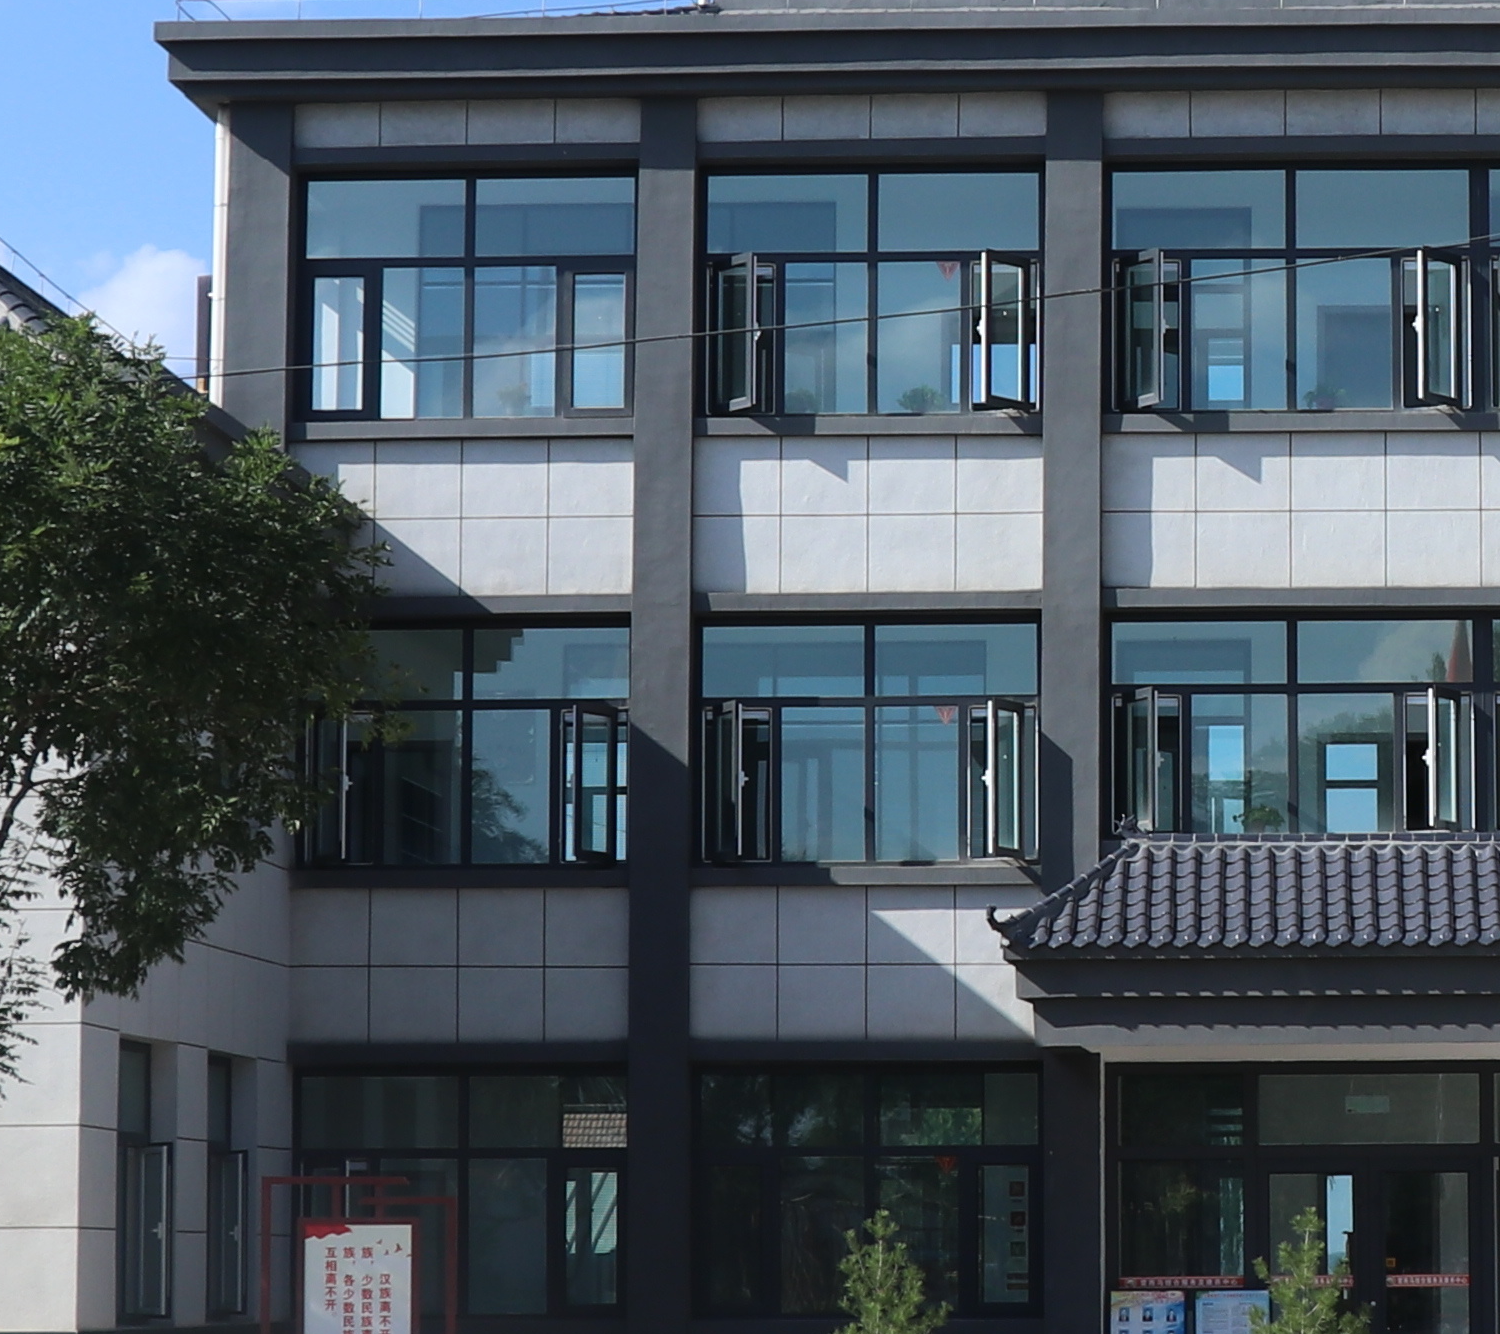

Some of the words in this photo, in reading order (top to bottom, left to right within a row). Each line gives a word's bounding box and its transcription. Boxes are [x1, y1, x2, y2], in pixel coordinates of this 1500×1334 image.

[324, 1246, 338, 1317] 互相离不开。
